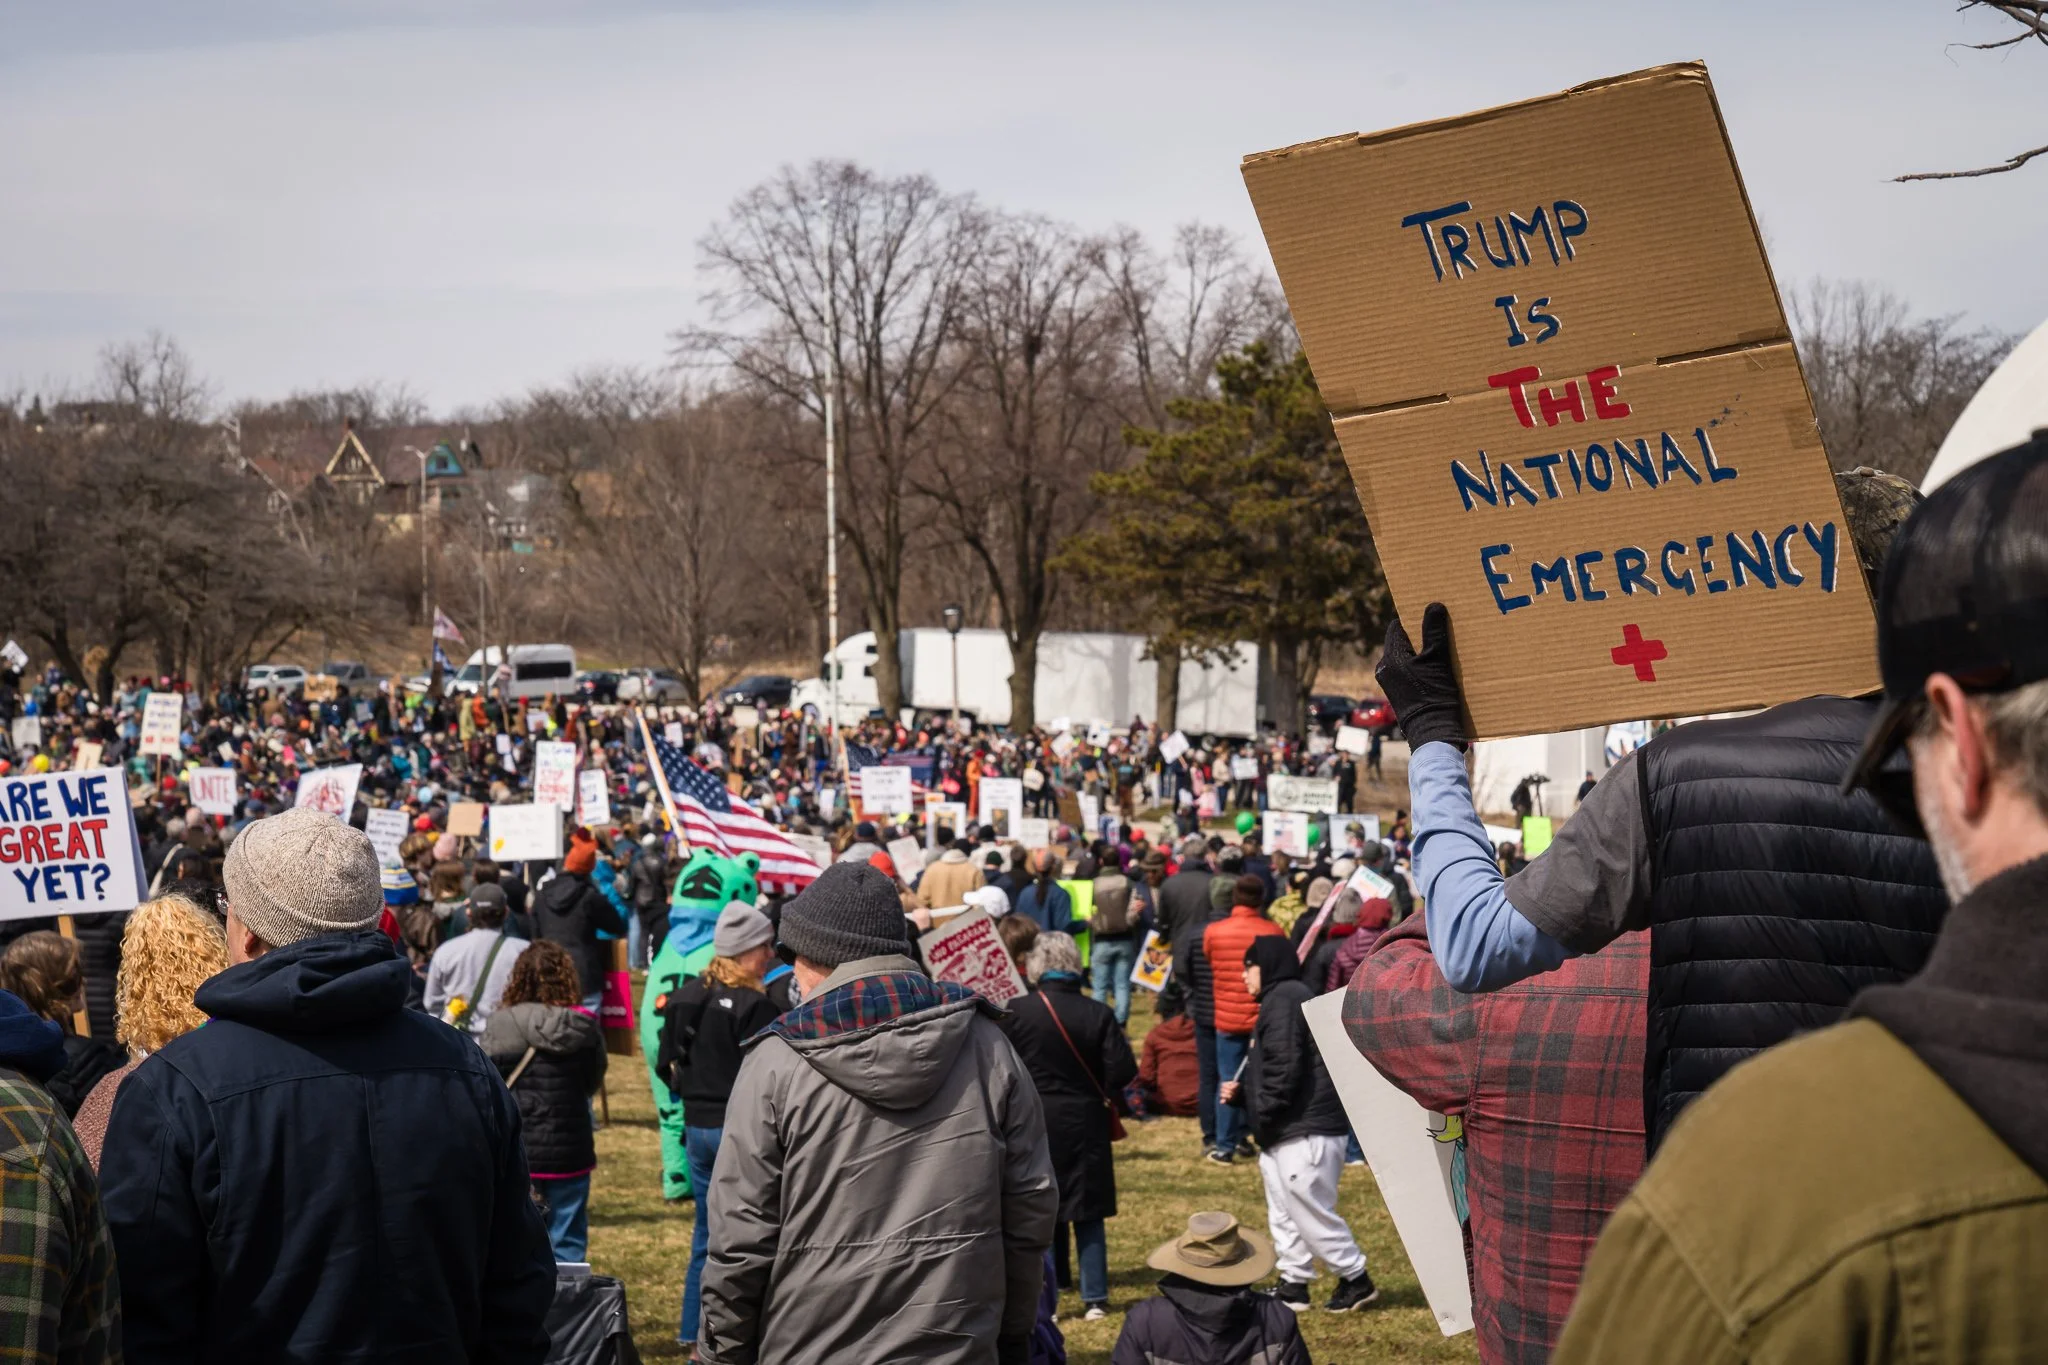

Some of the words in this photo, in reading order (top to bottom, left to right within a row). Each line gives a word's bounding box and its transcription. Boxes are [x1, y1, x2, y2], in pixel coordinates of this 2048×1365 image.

[1401, 200, 1588, 282] TRUMP
[1494, 295, 1562, 346] IS
[1488, 365, 1632, 428] THE
[1451, 427, 1738, 512] NATIONAL
[1481, 521, 1840, 614] EMERGENCY
[57, 775, 111, 818] WE
[0, 819, 108, 864] GREAT
[13, 863, 111, 903] YET?
